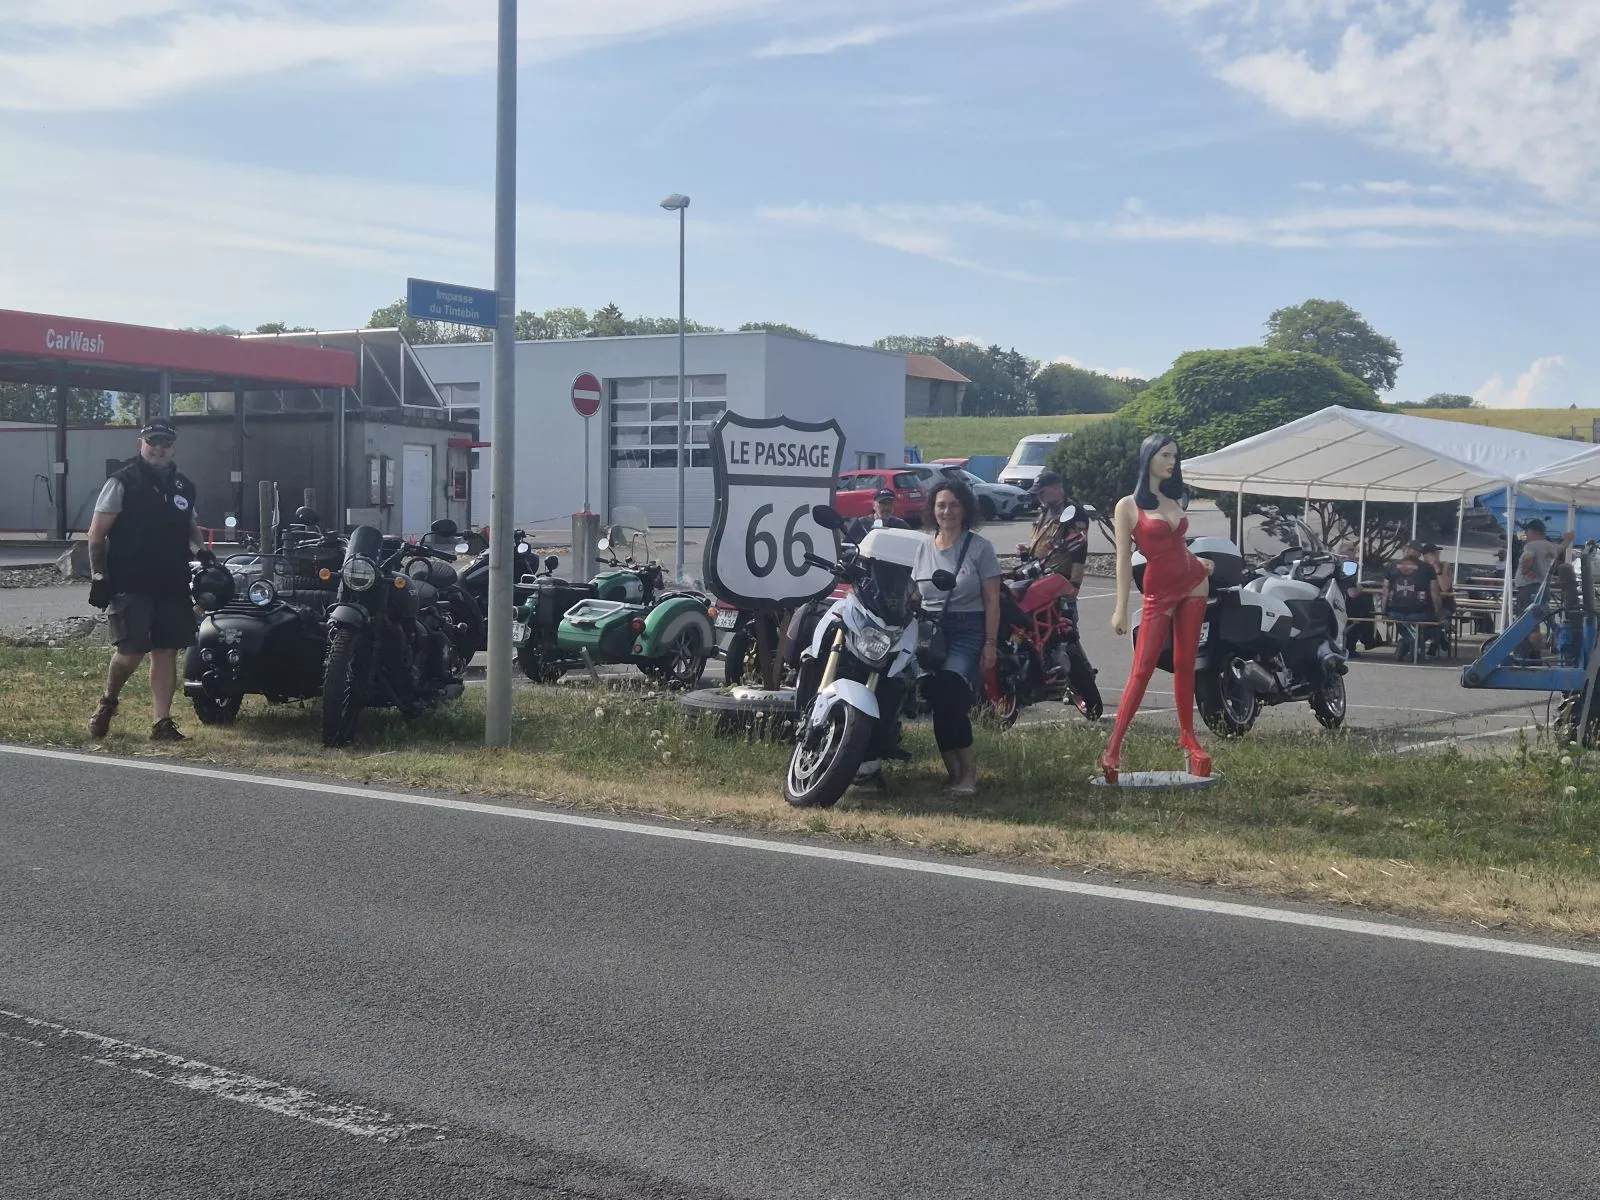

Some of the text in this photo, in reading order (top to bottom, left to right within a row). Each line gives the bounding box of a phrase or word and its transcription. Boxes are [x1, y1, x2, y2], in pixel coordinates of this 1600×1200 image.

[430, 303, 441, 314] du
[436, 289, 473, 304] Impasse
[46, 328, 105, 353] CarWash
[730, 440, 830, 468] LE PASSAGE
[745, 503, 814, 578] 66
